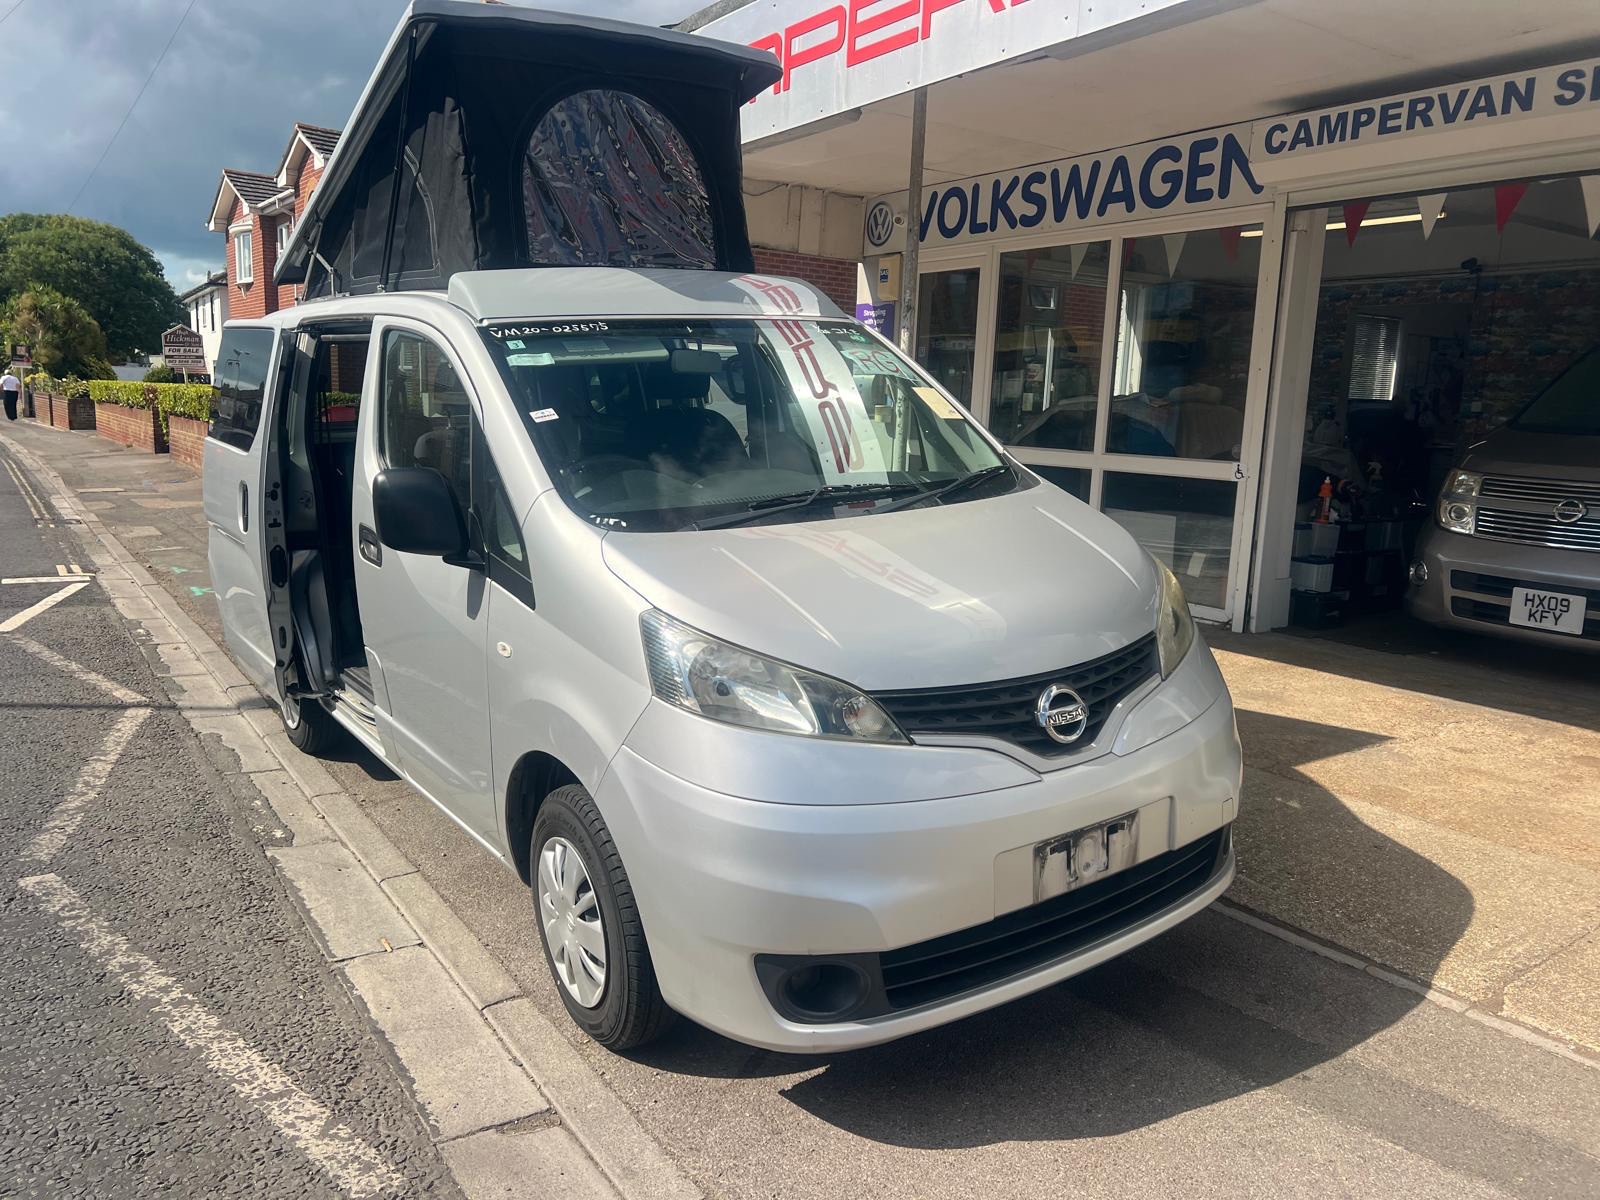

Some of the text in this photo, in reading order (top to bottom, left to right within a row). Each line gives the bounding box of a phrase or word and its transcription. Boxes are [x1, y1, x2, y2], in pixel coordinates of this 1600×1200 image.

[1264, 64, 1600, 155] CAMPERVAN S
[1524, 592, 1570, 613] HX09
[1528, 608, 1562, 626] KFY
[1047, 706, 1087, 724] NISSAN
